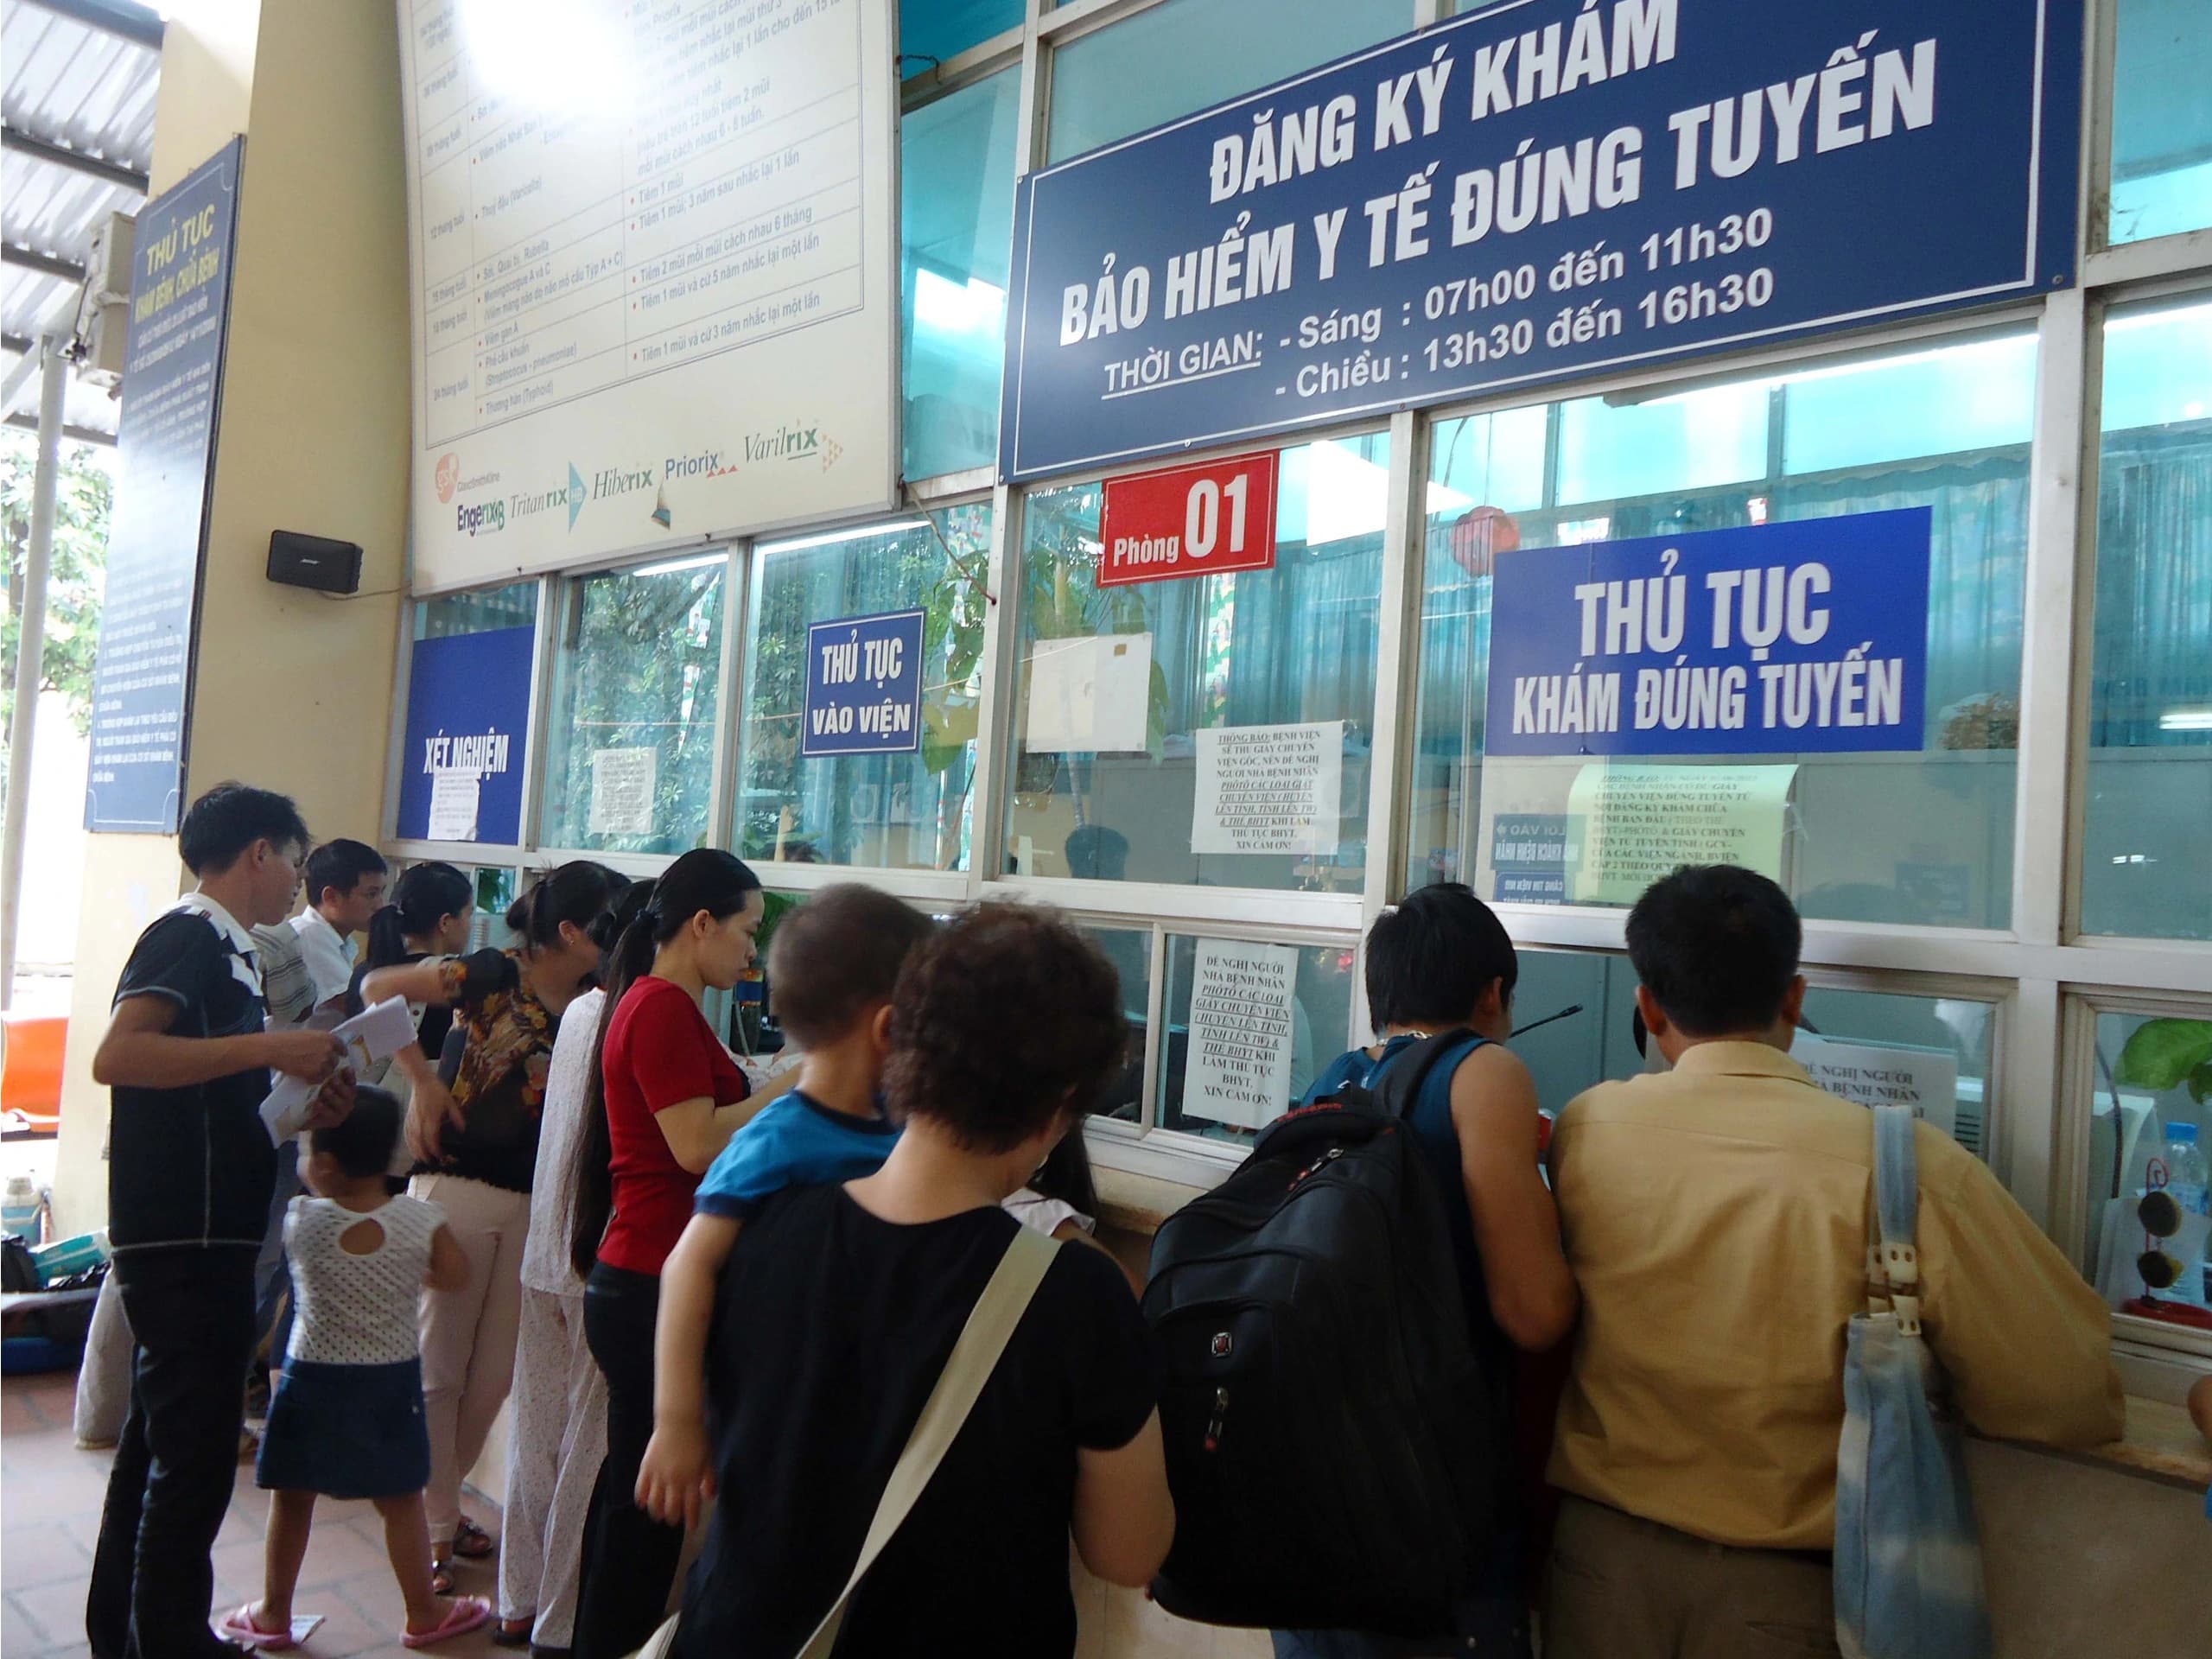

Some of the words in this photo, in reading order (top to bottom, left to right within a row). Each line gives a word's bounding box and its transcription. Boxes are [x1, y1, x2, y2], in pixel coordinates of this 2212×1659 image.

[1210, 94, 1357, 203] ĐĂNG
[1374, 43, 1454, 151] KÝ
[1471, 0, 1678, 121] KHÁM
[1059, 252, 1150, 346] BẢO
[1164, 211, 1295, 320] HIỂM
[1313, 207, 1348, 280] Y
[1363, 161, 1440, 268] TẾ
[1452, 126, 1643, 247] ĐÚNG
[1669, 29, 1937, 191] TUYẾN
[1103, 347, 1170, 393] THỜI
[1179, 331, 1263, 378] GIAN:
[1297, 307, 1382, 349] Sáng
[1424, 264, 1536, 321] 07h00
[1549, 240, 1624, 292] đến
[1641, 207, 1774, 272] 11h30
[1296, 349, 1390, 398] Chiều
[1423, 320, 1534, 372] 13h30
[1546, 299, 1623, 349] đến
[1639, 267, 1775, 328] 16h30
[664, 450, 719, 480] Priorix
[744, 424, 819, 464] Varilrix
[510, 486, 569, 519] Tritanrix
[593, 467, 652, 501] Hiberix
[1113, 533, 1179, 567] Phòng
[1185, 474, 1248, 558] 01
[1574, 549, 1687, 657] THỦ
[1706, 563, 1832, 662] TỤC
[822, 628, 859, 685] THỦ
[864, 638, 903, 689] TỤC
[1512, 663, 1621, 734] KHÁM
[1634, 655, 1747, 730] ĐÚNG
[1759, 641, 1904, 728] TUYẾN
[423, 728, 450, 774] XÉT
[452, 727, 510, 781] NGHIỆM
[812, 701, 854, 735] VÀO
[859, 698, 911, 740] VIỆN
